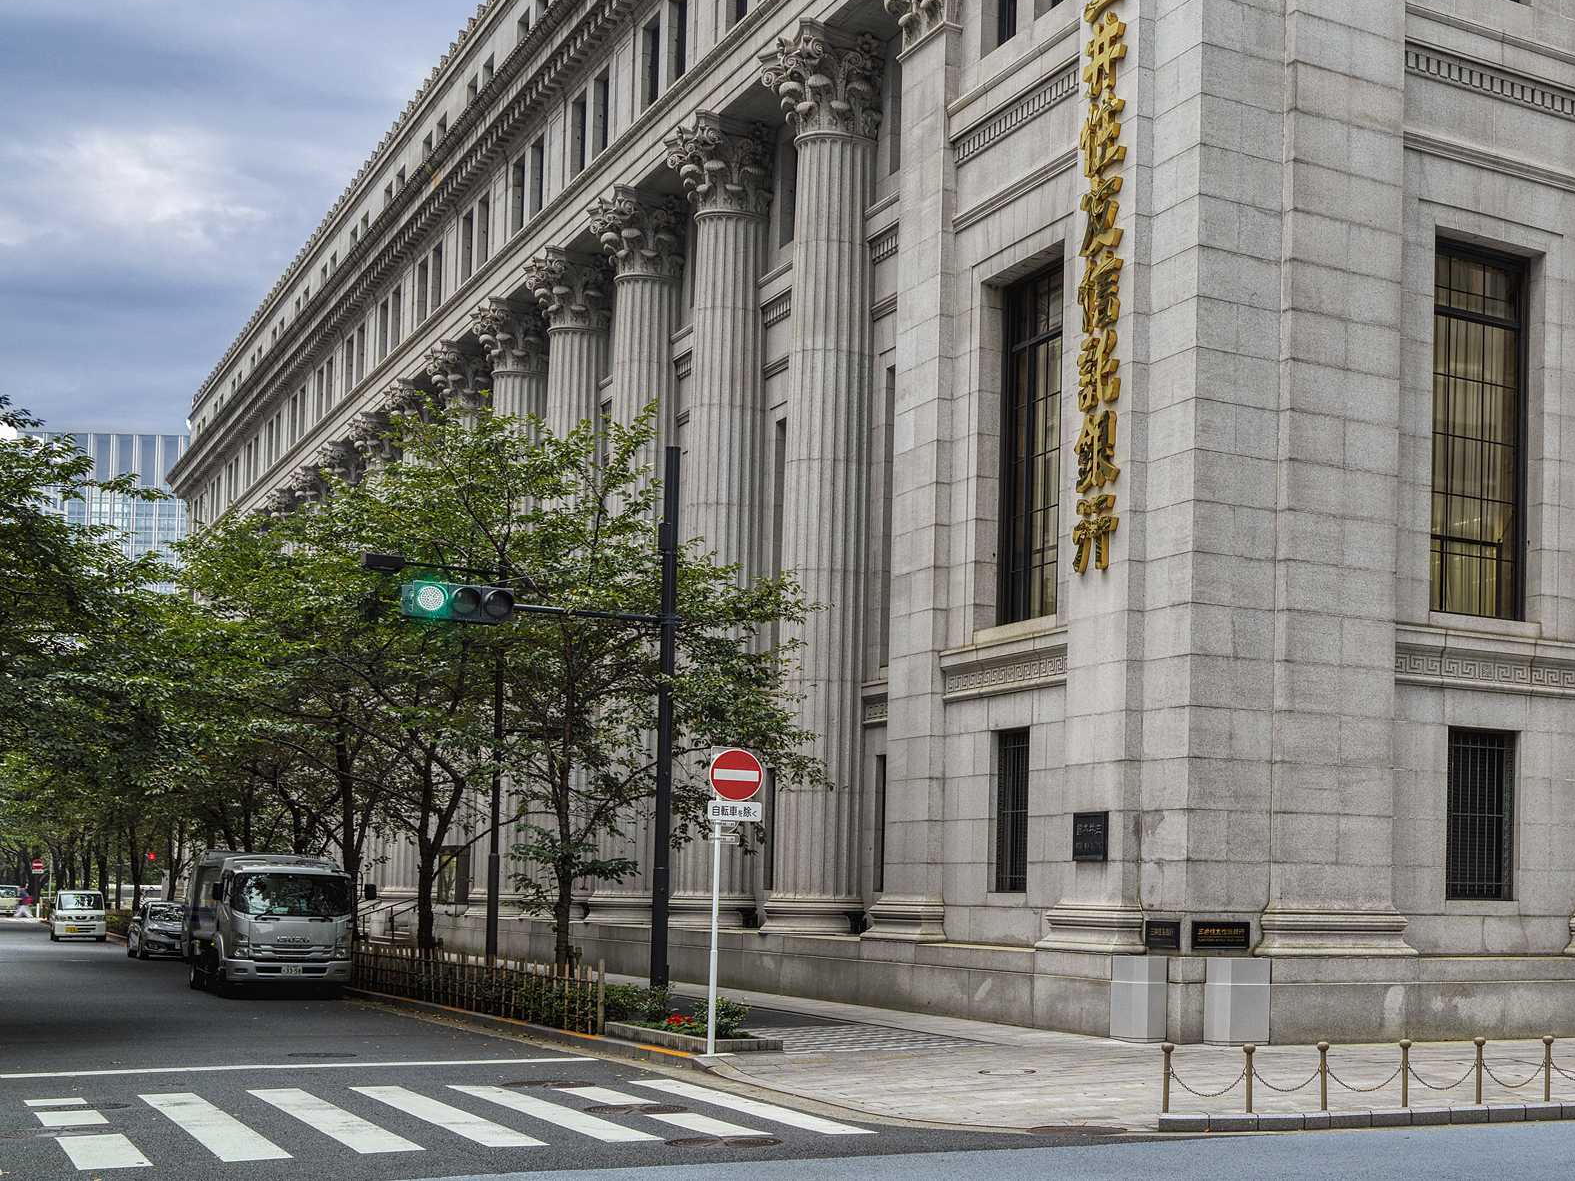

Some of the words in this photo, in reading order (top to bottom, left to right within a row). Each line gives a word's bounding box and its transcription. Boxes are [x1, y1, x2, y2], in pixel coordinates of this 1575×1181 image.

[712, 805, 757, 818] 自転車を除く
[276, 935, 310, 943] ISUZU
